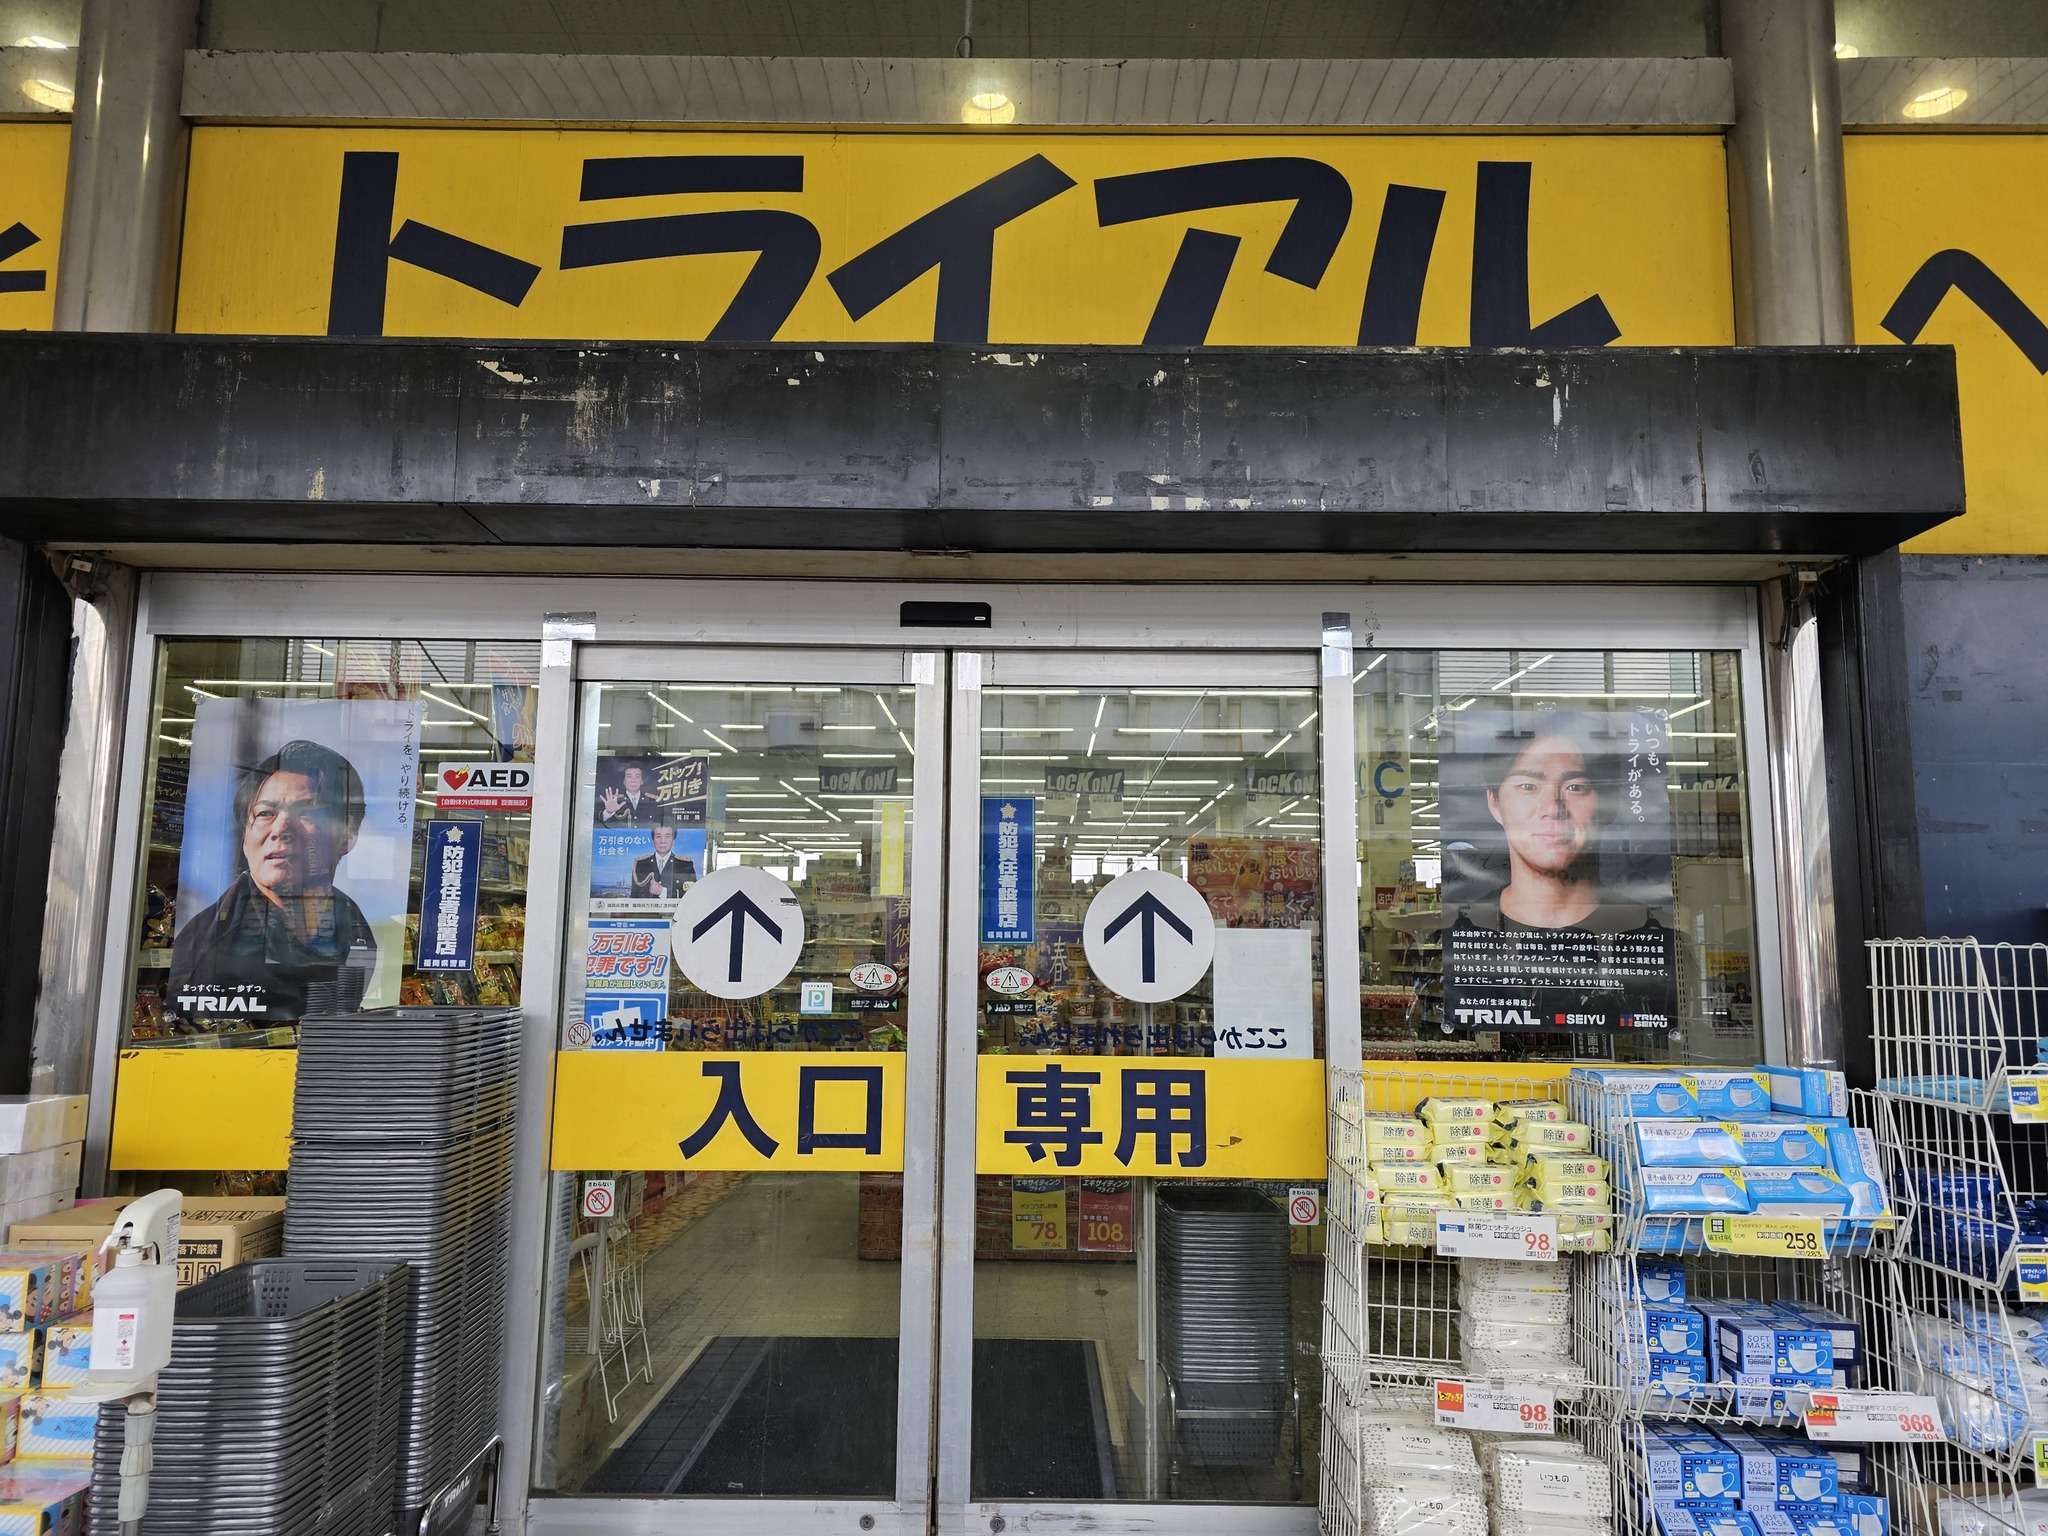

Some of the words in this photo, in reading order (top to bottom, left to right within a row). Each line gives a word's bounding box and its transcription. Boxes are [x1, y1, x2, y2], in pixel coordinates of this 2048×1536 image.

[328, 151, 1622, 347] トライアル
[1645, 723, 1661, 774] いつも、
[397, 709, 415, 829] トライを、やり続ける。
[1627, 722, 1645, 822] トライがある。
[467, 769, 530, 788] AED
[821, 769, 866, 791] LOCK
[865, 768, 896, 790] ON!
[1047, 771, 1093, 792] LOCK
[1092, 772, 1123, 793] ON!
[1248, 772, 1297, 794] LOCK
[1294, 774, 1316, 793] ON
[1374, 761, 1405, 798] C
[655, 778, 703, 802] 万引き
[598, 835, 651, 845] 万引きのない
[1192, 860, 1240, 875] おいしい
[997, 821, 1019, 929] 防犯責任者設置店
[435, 845, 465, 955] 防犯責任者設置店
[987, 931, 1028, 939] 福岡県警察
[590, 932, 654, 954] 万引は
[423, 959, 467, 968] 福岡県警察
[182, 983, 267, 993] まっすぐに。一歩ずつ。
[586, 979, 667, 989] 警備員が巡回しています。
[177, 996, 267, 1012] TRIAL
[1455, 1009, 1541, 1025] TRIAL
[1566, 1014, 1606, 1025] SEIYU
[1587, 1032, 1599, 1057] 画中
[1685, 1079, 1696, 1087] 50
[678, 1061, 884, 1160] 入口
[1003, 1063, 1208, 1168] 専用
[1452, 1106, 1473, 1118] 除菌
[1383, 1126, 1405, 1137] 除菌
[1450, 1126, 1471, 1136] 除菌
[1543, 1128, 1565, 1141] 除菌
[1383, 1147, 1404, 1158] 除菌
[1445, 1146, 1467, 1158] 除菌
[1562, 1163, 1585, 1175] 除菌
[1729, 1169, 1741, 1177] 50
[1015, 1178, 1061, 1187] エキサイティング
[1082, 1179, 1130, 1188] エキサイティング
[1395, 1172, 1417, 1184] 除菌
[1469, 1173, 1491, 1185] 除菌
[1562, 1185, 1585, 1197] 除菌
[1030, 1222, 1058, 1240] 78
[1087, 1222, 1124, 1242] 108
[1468, 1222, 1532, 1232] 除菌ウェットティッシュ
[1524, 1233, 1550, 1251] 98
[1784, 1232, 1818, 1250] 258
[177, 1243, 218, 1255] 落下厳禁
[1536, 1251, 1552, 1259] 107
[1746, 1342, 1772, 1350] MASK
[1519, 1404, 1547, 1422] 98
[1898, 1414, 1935, 1432] 368
[1748, 1461, 1772, 1469] SOFT
[1539, 1473, 1570, 1483] いつもの
[1747, 1468, 1773, 1476] MASK
